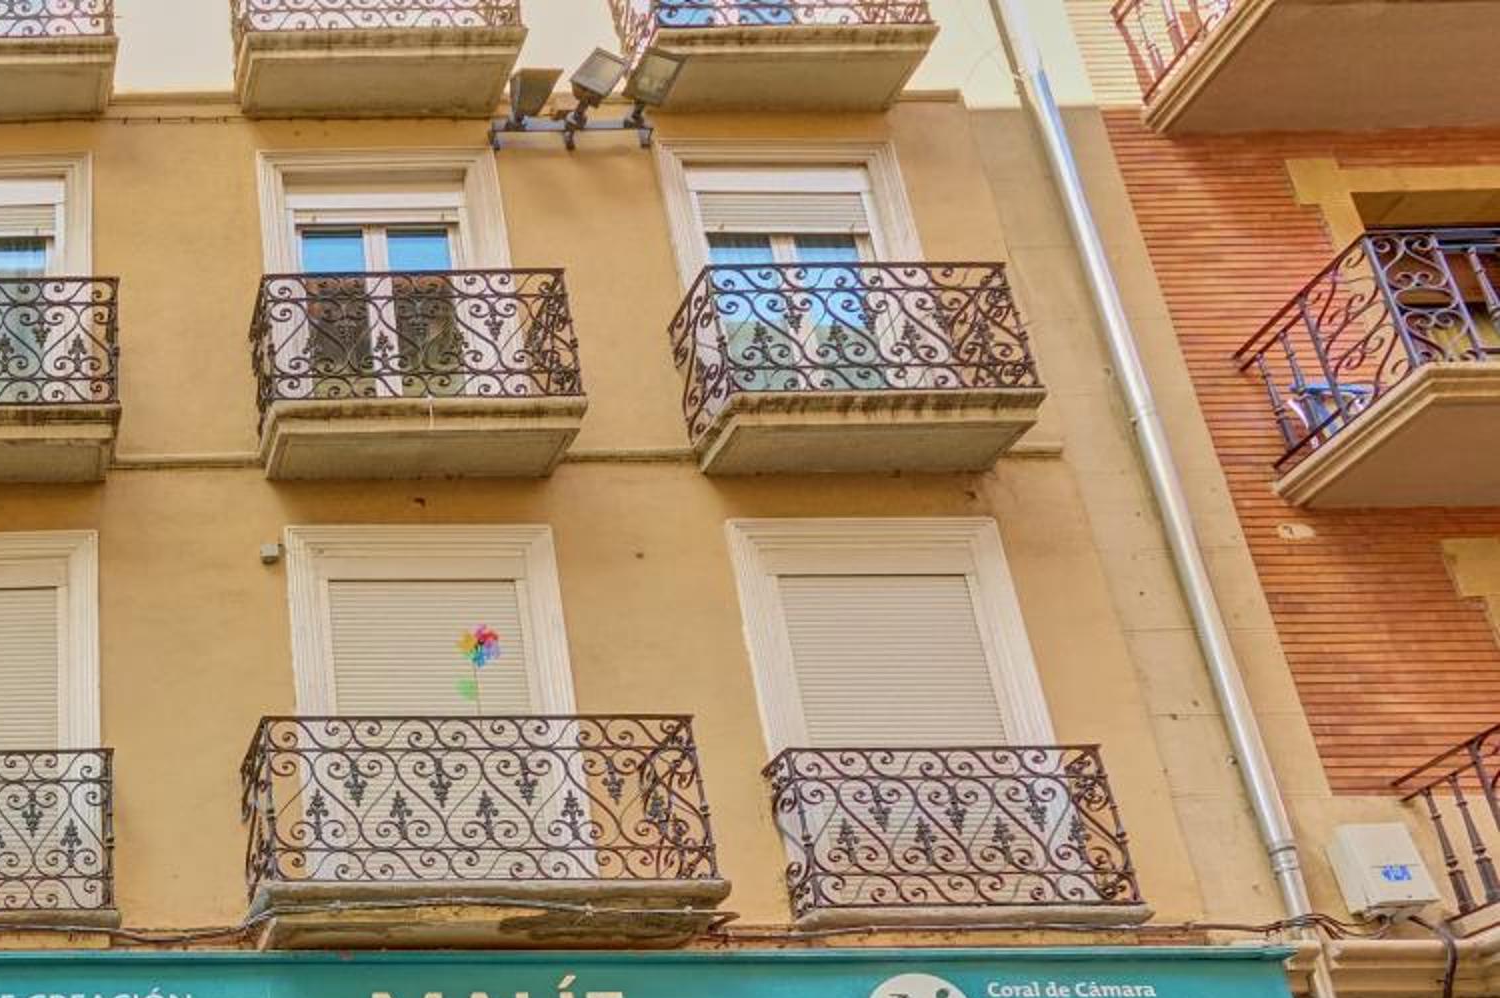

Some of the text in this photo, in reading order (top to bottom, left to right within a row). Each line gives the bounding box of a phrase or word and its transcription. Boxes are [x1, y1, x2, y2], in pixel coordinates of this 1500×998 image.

[987, 981, 1156, 998] Coral de Cámara
